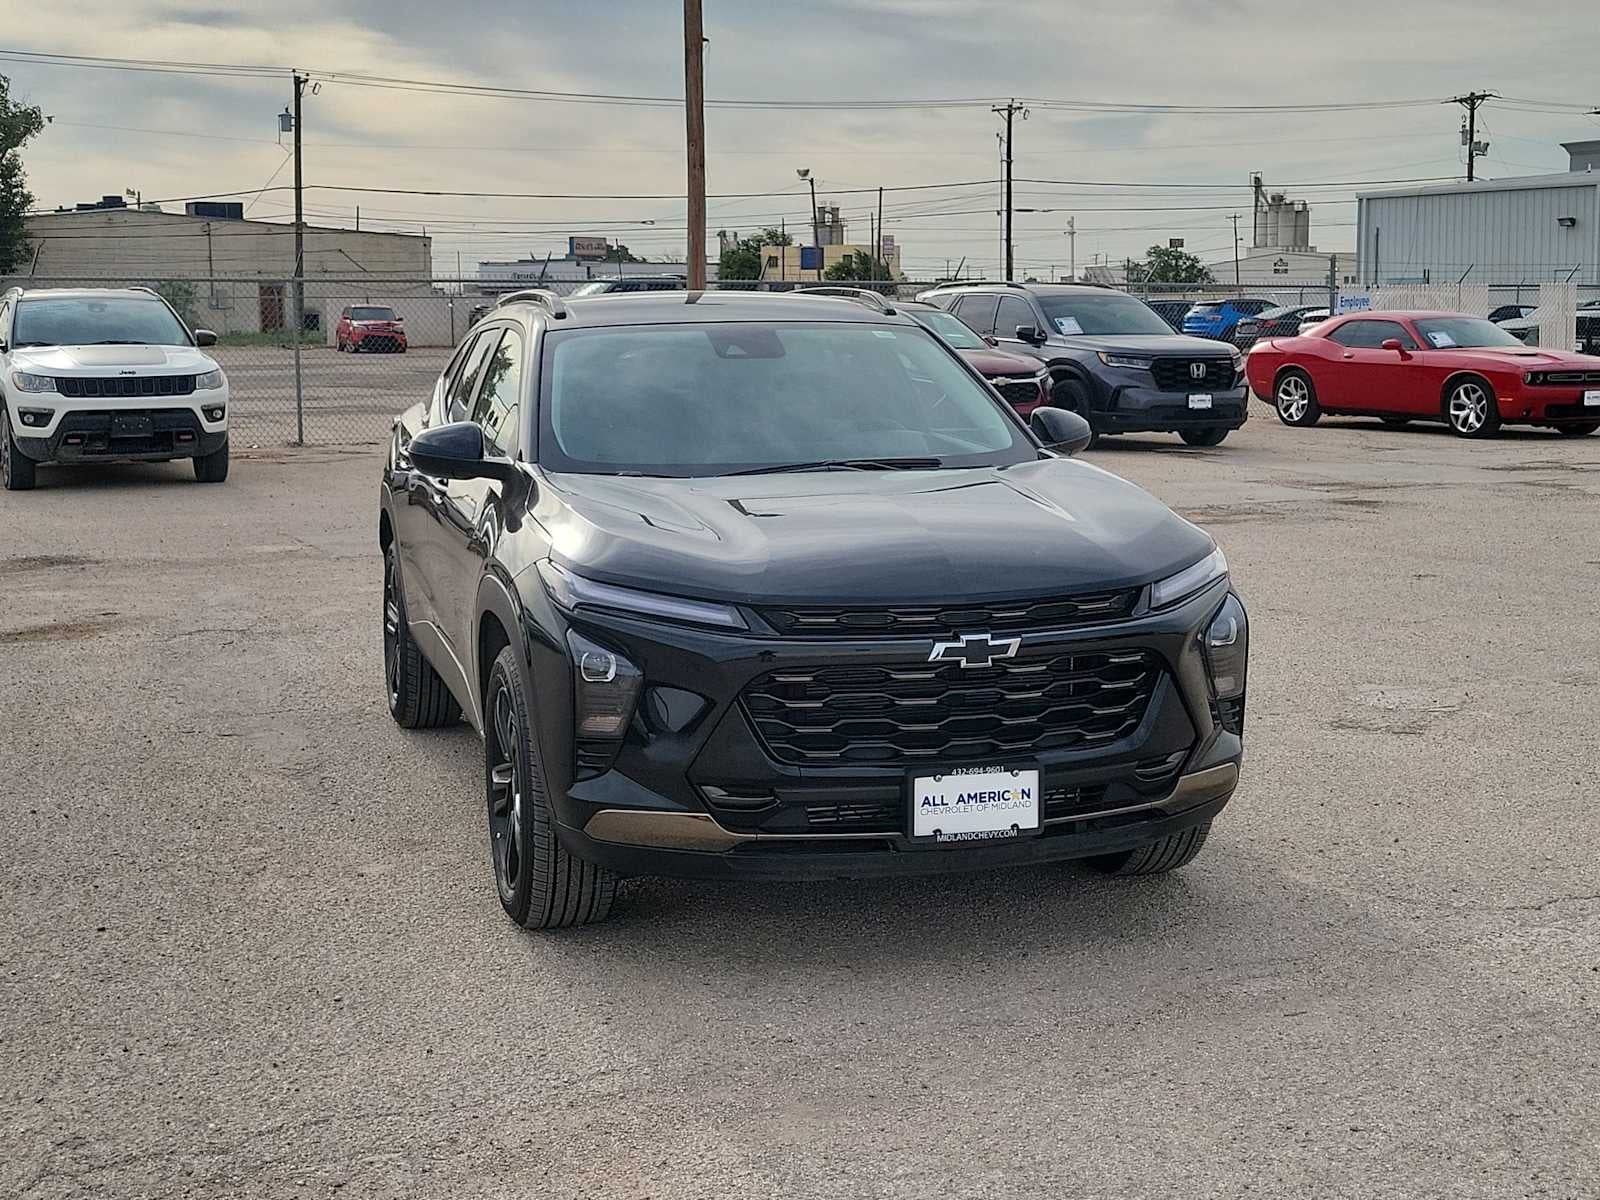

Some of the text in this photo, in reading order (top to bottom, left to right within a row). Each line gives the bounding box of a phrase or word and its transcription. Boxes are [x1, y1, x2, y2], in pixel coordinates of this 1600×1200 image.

[1340, 295, 1370, 310] Employee
[951, 765, 1004, 776] 432-694-9601
[920, 800, 1032, 816] CHEVROLET OF MIDLAND
[921, 795, 949, 808] ALL
[937, 829, 1018, 843] MIDLANDCHEVY.COM
